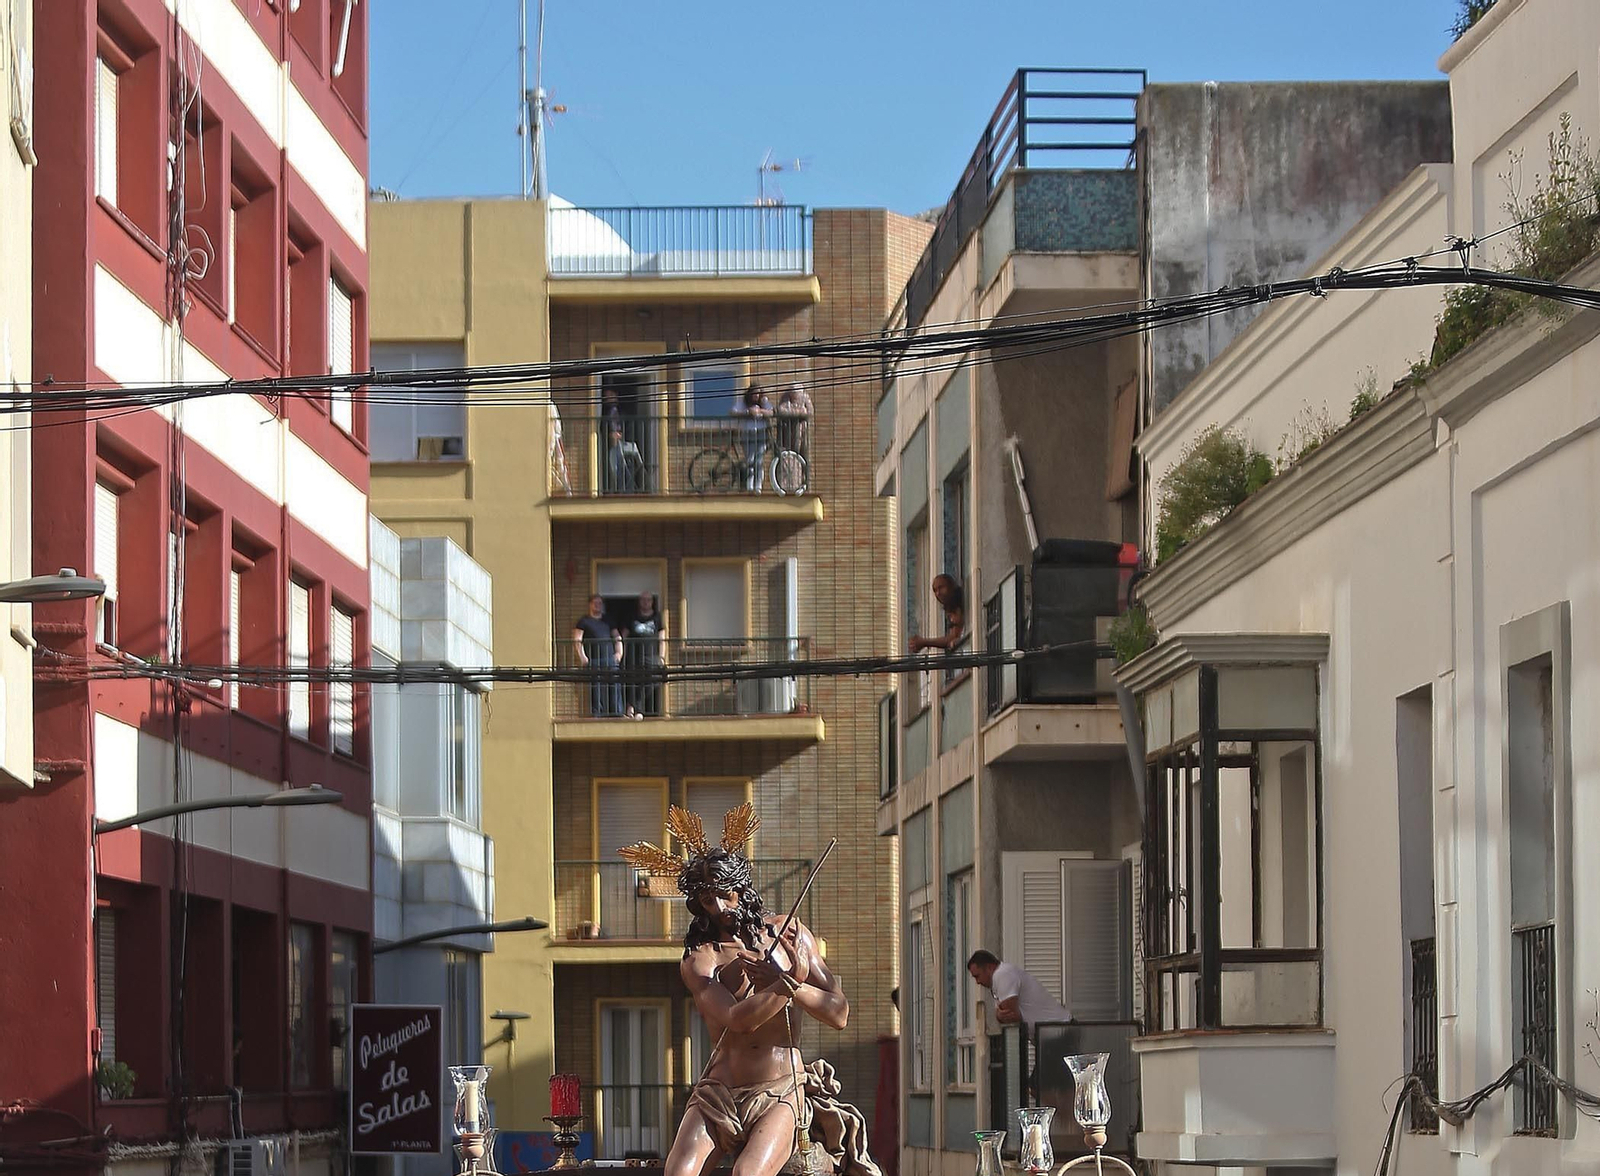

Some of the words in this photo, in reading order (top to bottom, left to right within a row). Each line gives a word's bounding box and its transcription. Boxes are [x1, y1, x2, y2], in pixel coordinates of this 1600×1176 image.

[381, 1060, 409, 1091] de
[358, 1090, 432, 1134] Salas
[400, 1140, 432, 1149] PLANTA
